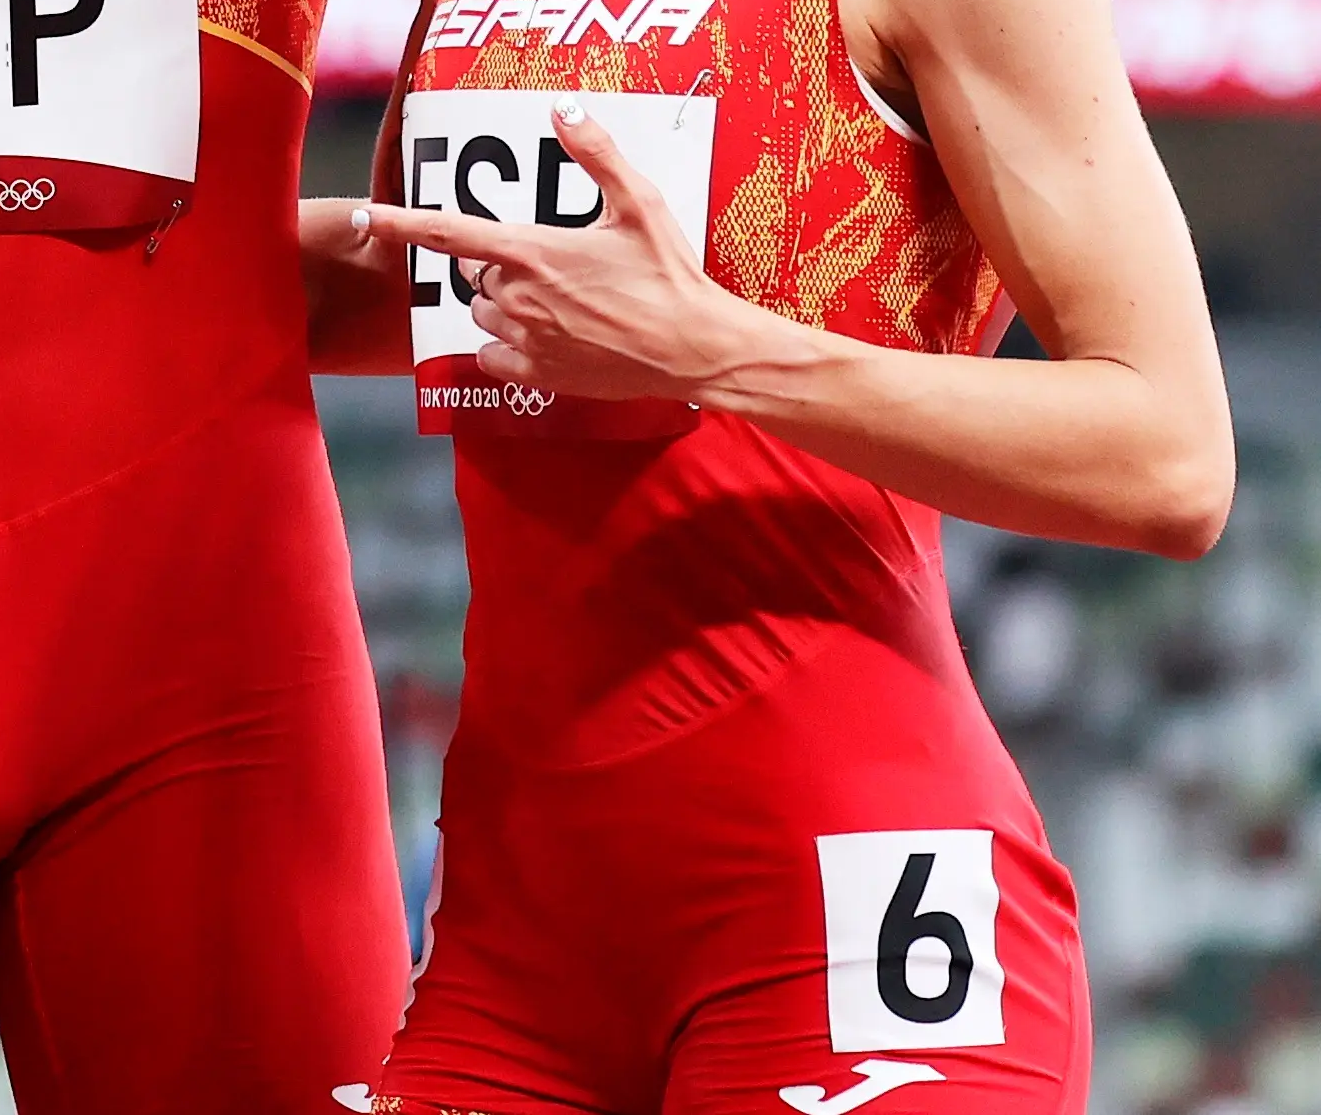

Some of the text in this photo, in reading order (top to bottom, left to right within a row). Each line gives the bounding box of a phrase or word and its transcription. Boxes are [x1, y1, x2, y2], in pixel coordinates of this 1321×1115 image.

[420, 387, 500, 408] TOKYO 2020
[876, 853, 974, 1024] 6
